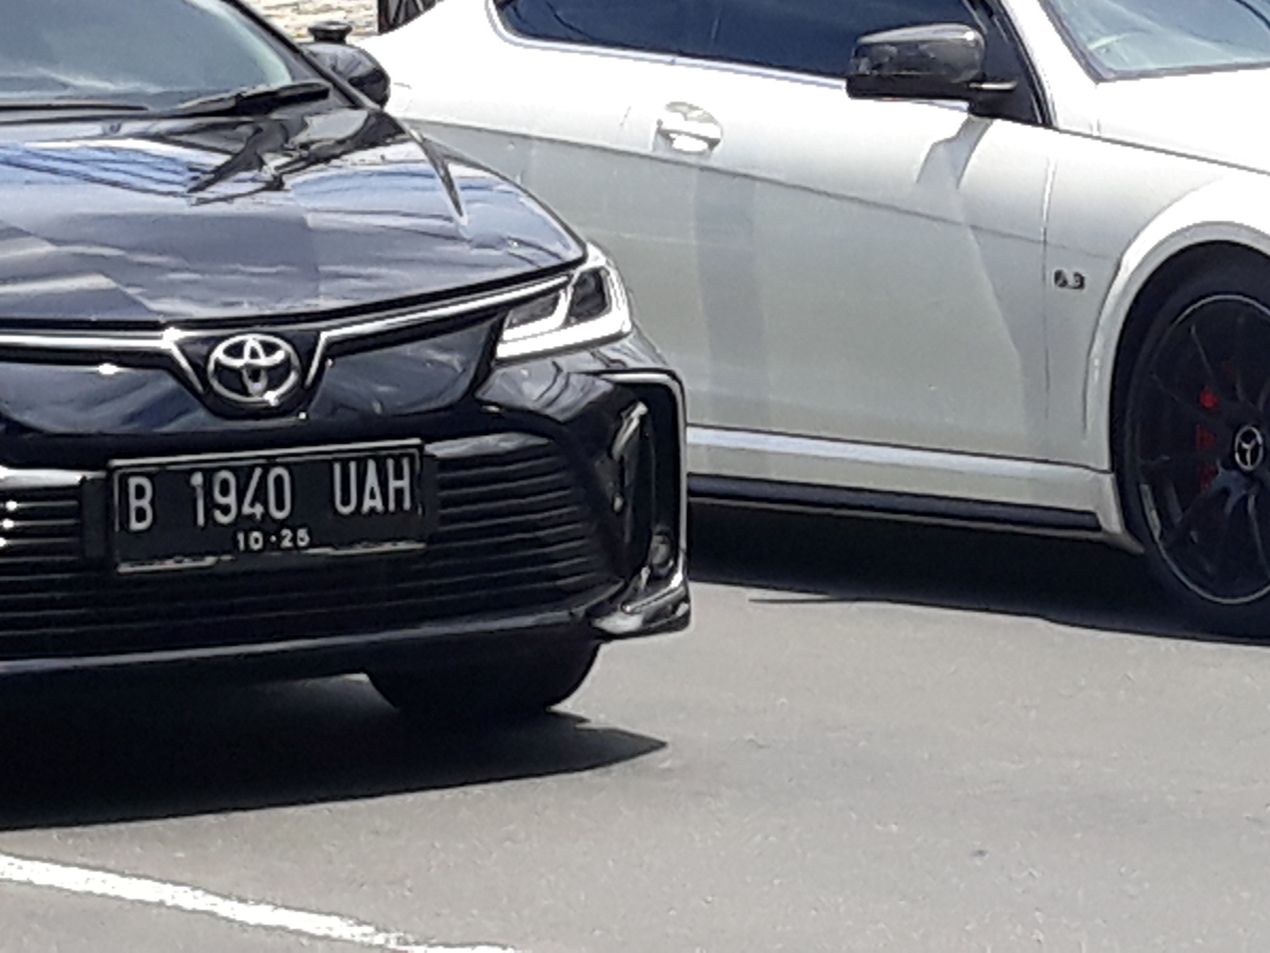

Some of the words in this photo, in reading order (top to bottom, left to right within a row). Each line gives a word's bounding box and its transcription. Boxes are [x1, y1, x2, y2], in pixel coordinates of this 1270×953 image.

[127, 475, 153, 532] B
[190, 464, 292, 528] 1940
[332, 456, 412, 515] UAH
